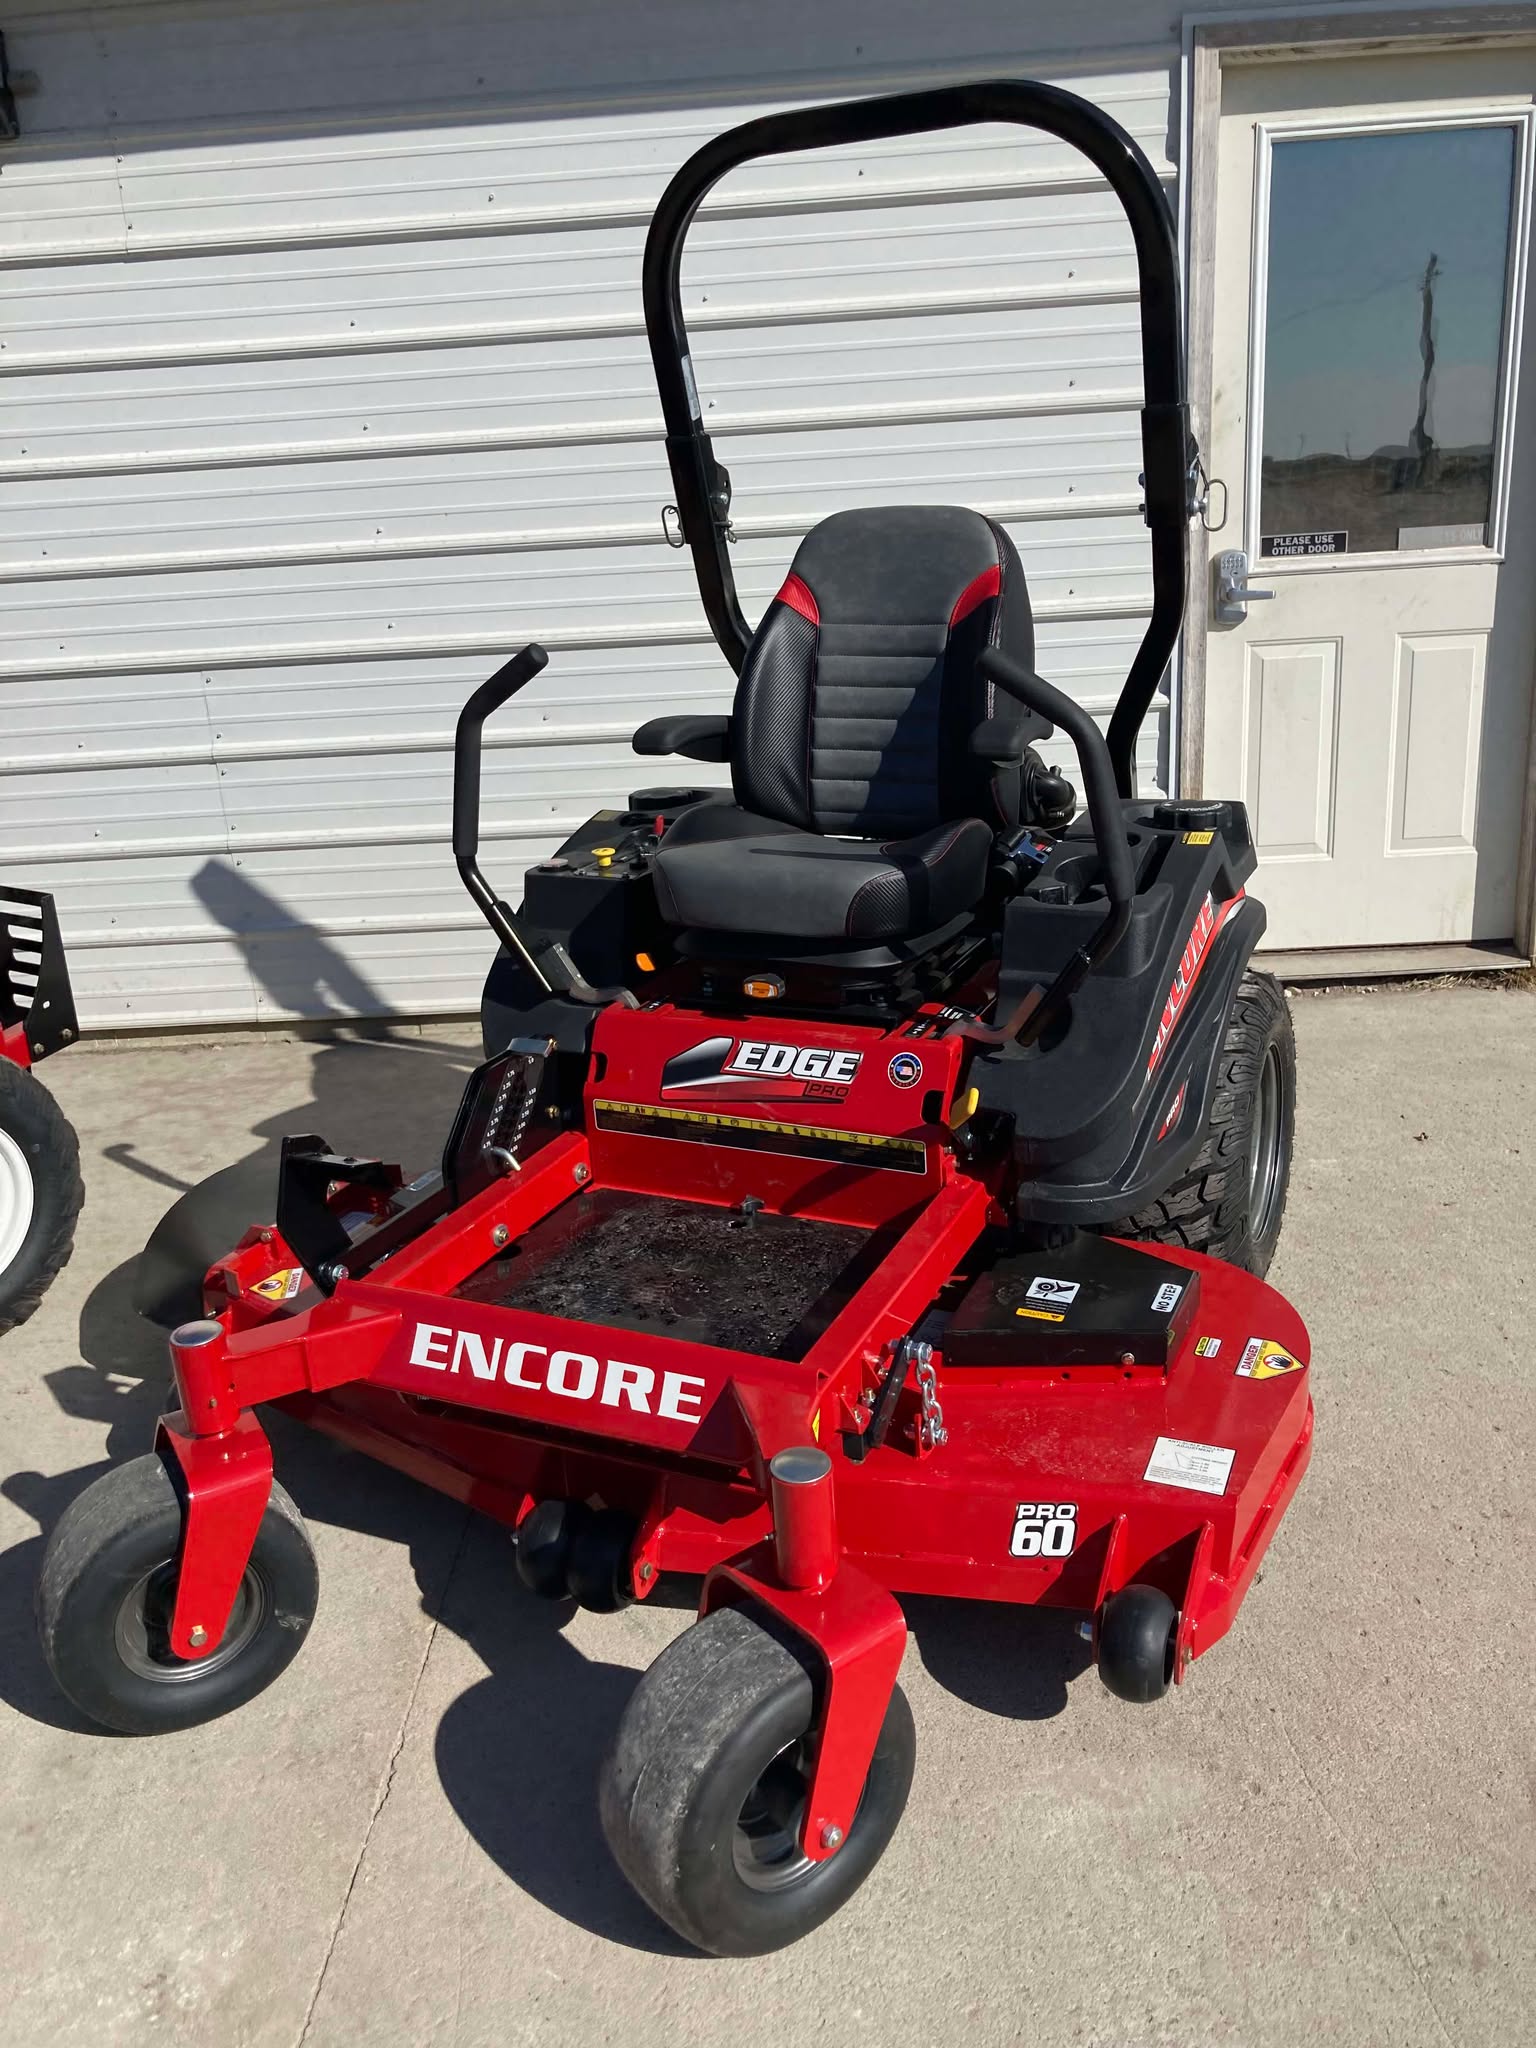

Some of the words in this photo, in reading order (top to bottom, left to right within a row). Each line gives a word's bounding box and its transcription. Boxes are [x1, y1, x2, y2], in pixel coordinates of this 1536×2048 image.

[1271, 546, 1305, 556] OTHER
[1308, 544, 1336, 553] DOOR
[1273, 535, 1311, 546] PLEASE
[1314, 534, 1335, 544] USE
[730, 1040, 862, 1082] EDGE
[808, 1083, 850, 1097] PRO
[1166, 1095, 1181, 1127] PRO
[1156, 1302, 1170, 1311] NO
[1163, 1284, 1178, 1302] STEP
[1241, 1344, 1259, 1370] DANGER
[409, 1322, 705, 1424] ENCORE
[1017, 1504, 1076, 1519] PRO
[1011, 1519, 1075, 1557] 60
